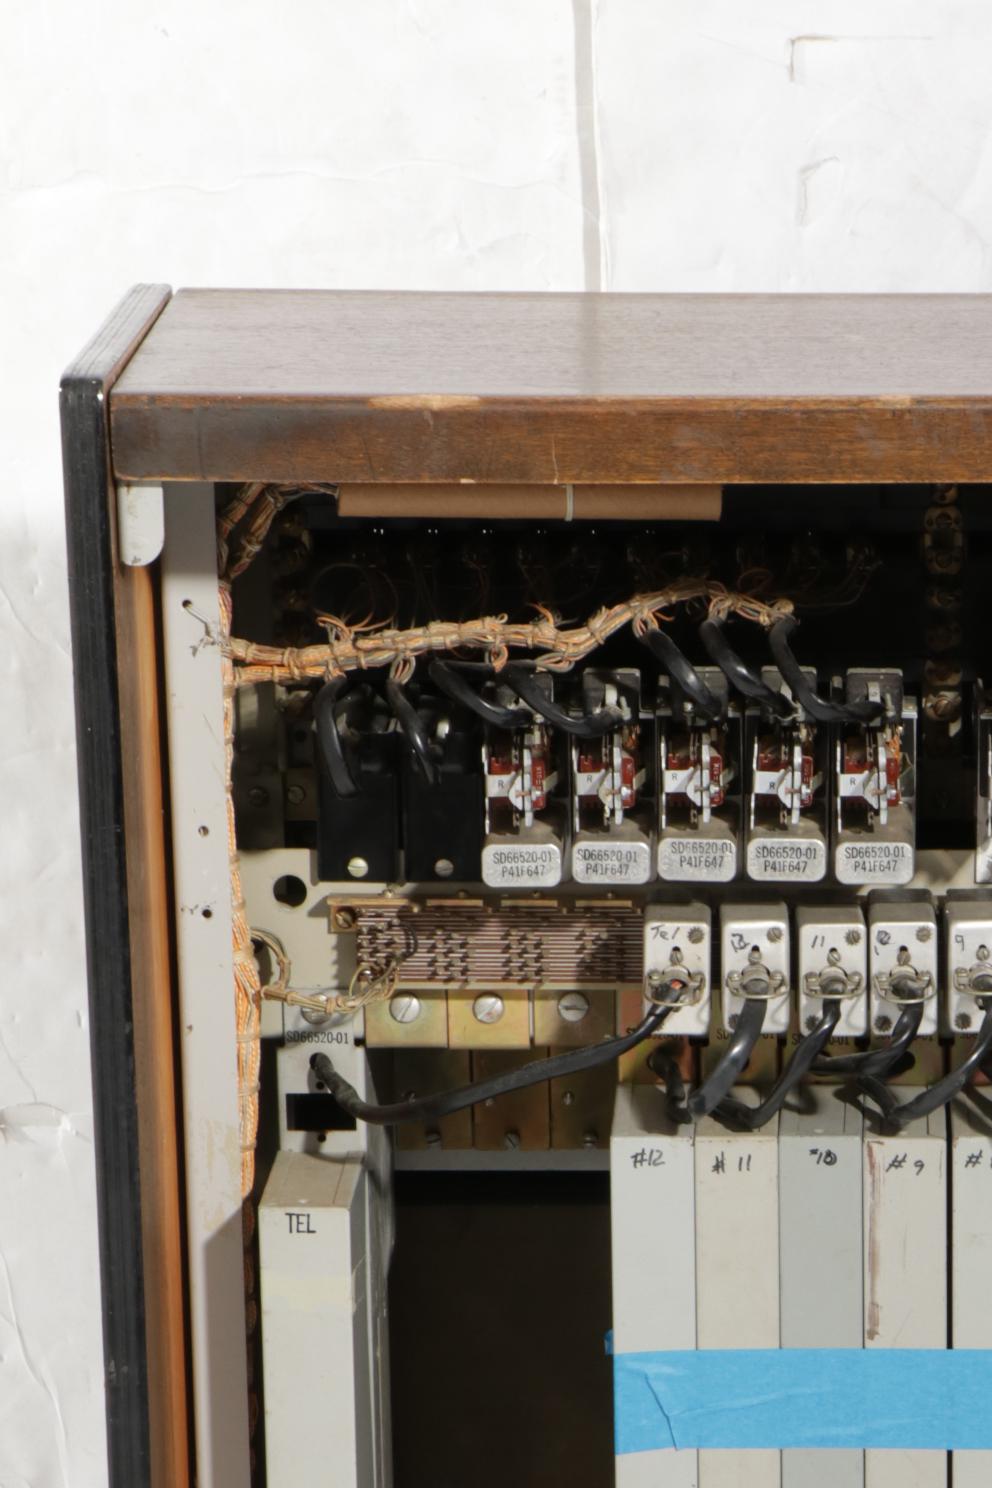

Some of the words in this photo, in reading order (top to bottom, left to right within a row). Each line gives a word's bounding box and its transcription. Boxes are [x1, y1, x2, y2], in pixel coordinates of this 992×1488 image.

[671, 841, 733, 854] SD66520-01
[755, 846, 817, 859] SD66520-01
[845, 846, 905, 859] SD66520-01
[493, 850, 552, 864] SD66520-01
[577, 849, 637, 863] SD66520-01
[650, 925, 679, 941] Tel
[286, 1031, 349, 1045] SD66520-01
[630, 1148, 666, 1168] #12
[285, 1212, 316, 1234] TEL
